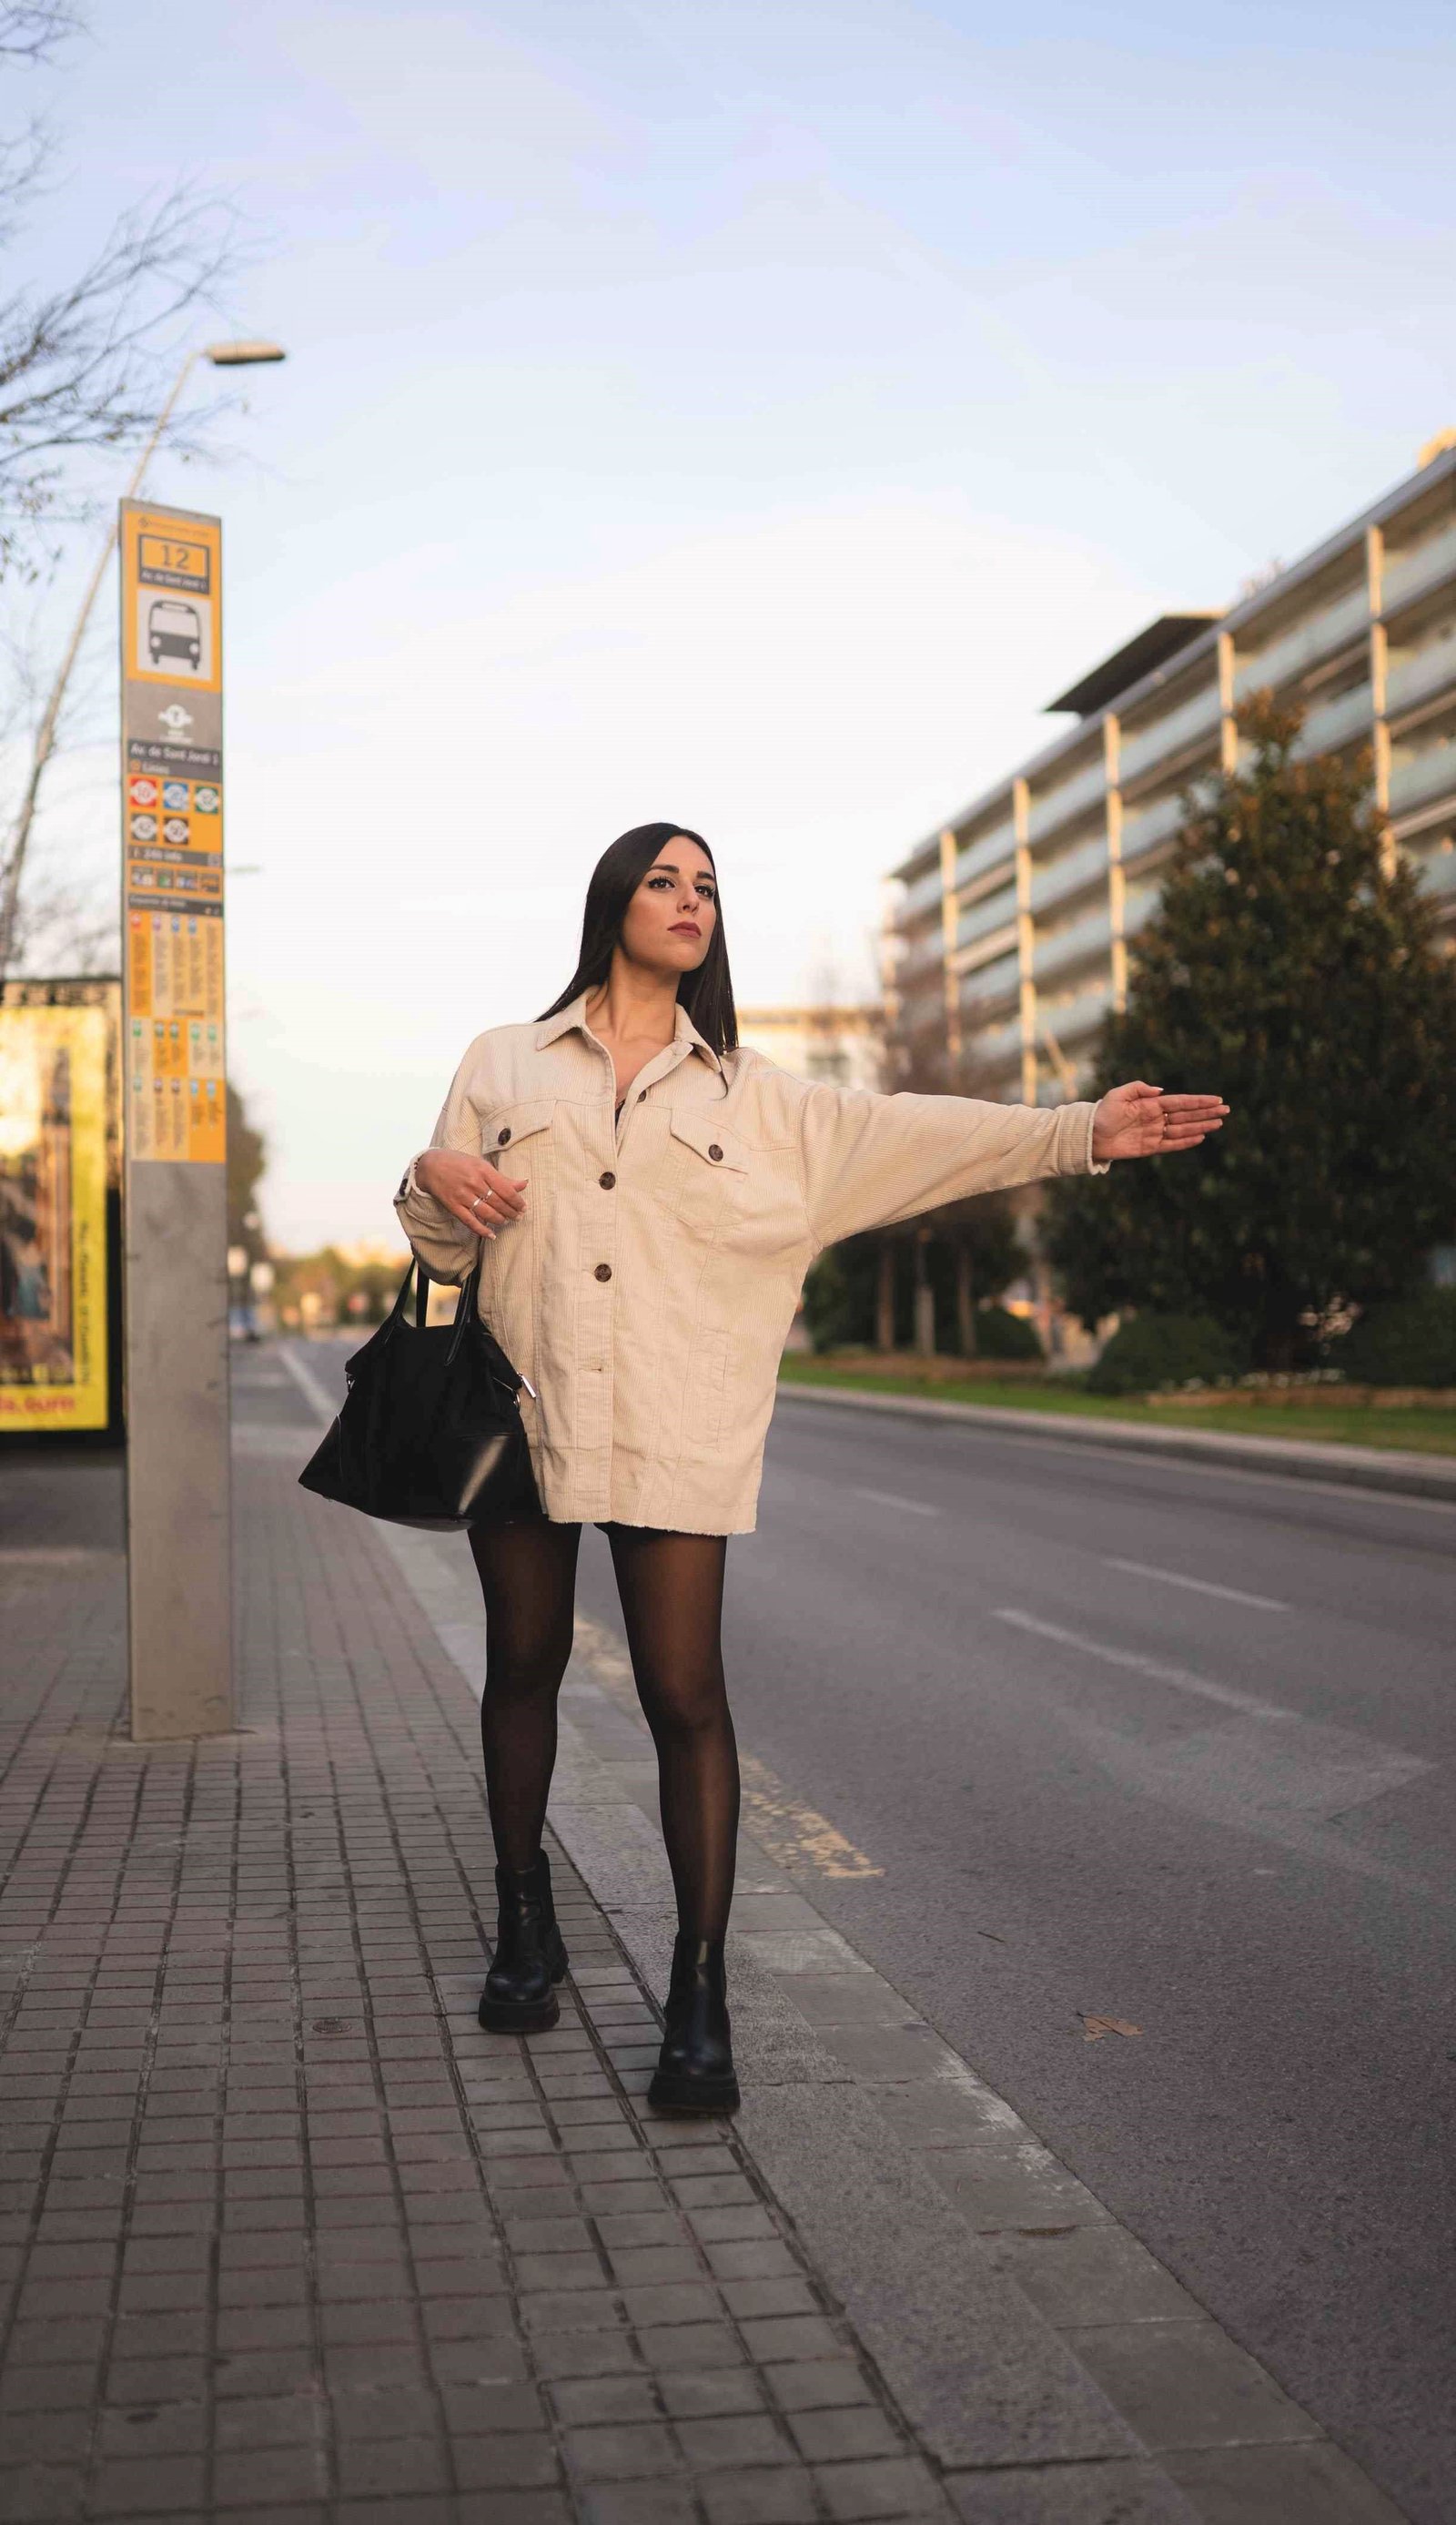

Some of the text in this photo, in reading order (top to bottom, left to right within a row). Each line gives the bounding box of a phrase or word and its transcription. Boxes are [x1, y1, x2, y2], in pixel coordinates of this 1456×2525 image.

[161, 544, 189, 570] 12
[148, 745, 162, 757] de
[163, 745, 187, 762] Sant
